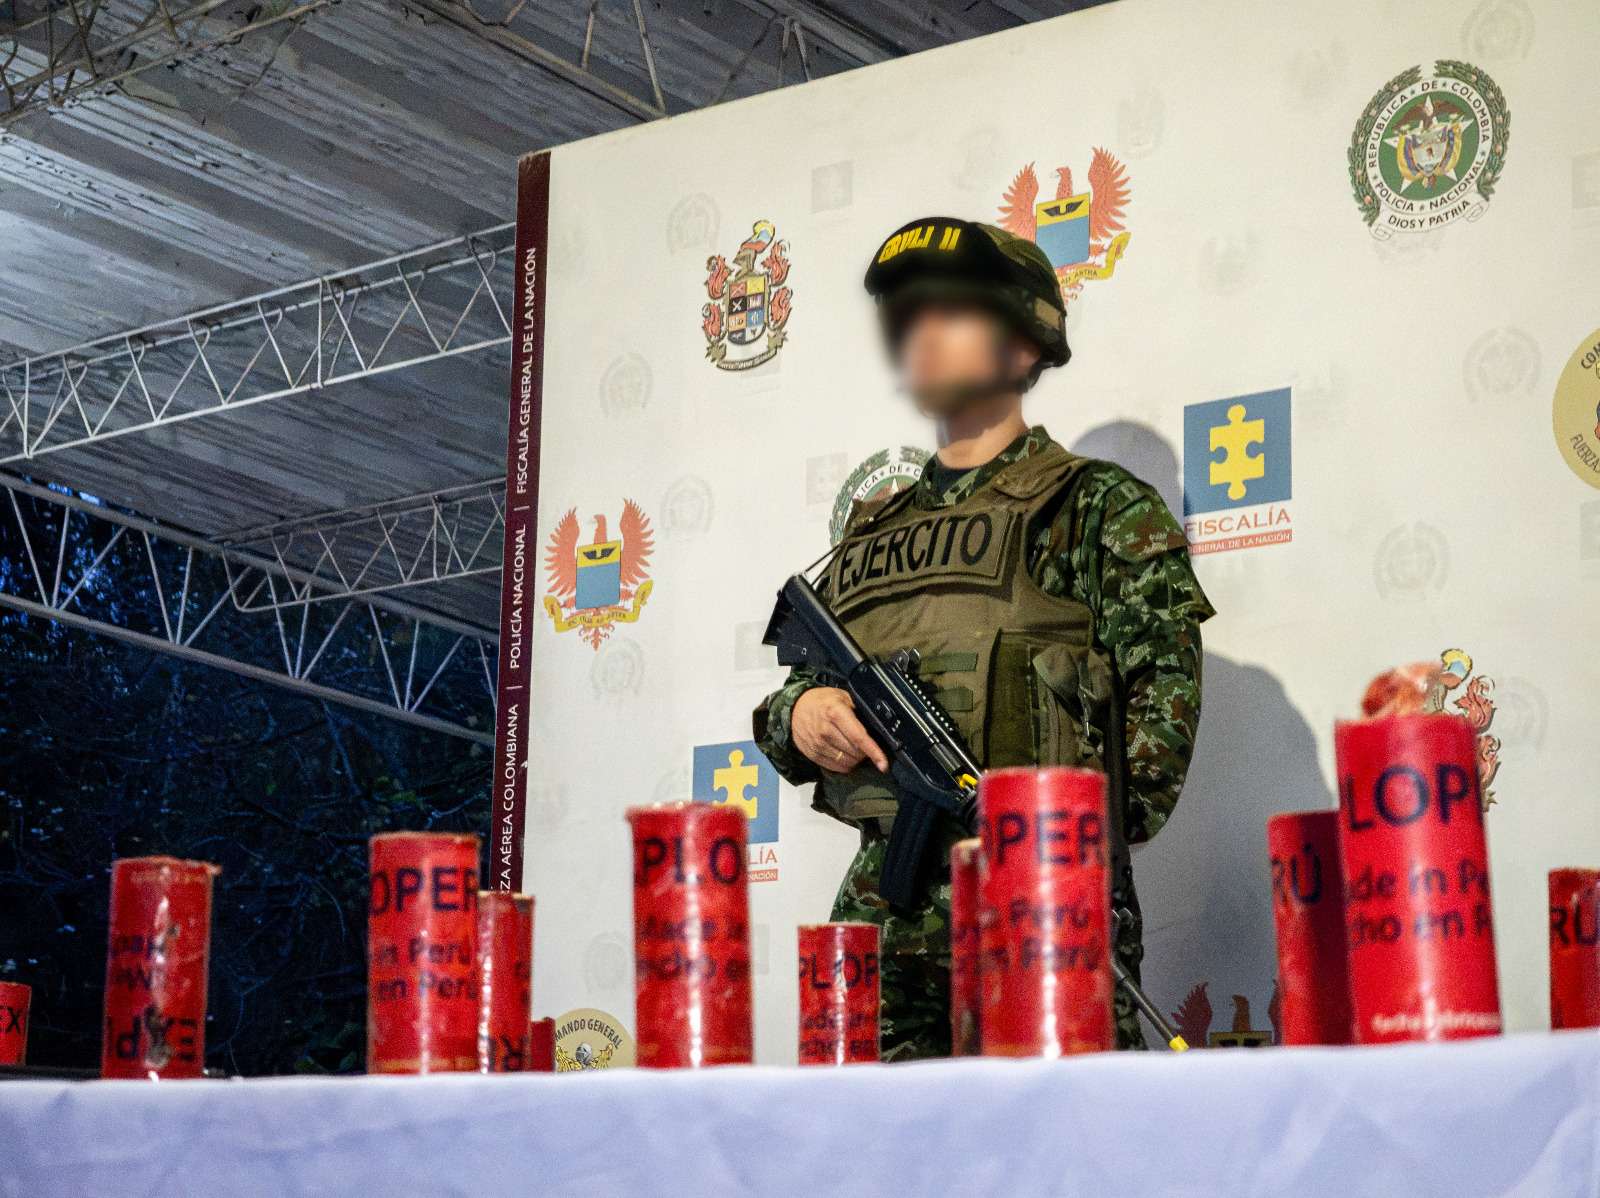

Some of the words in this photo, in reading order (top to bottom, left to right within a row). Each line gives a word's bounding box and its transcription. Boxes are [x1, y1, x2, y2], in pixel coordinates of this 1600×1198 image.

[1421, 80, 1438, 92] DE
[1451, 82, 1490, 143] COLOMBIA
[1429, 159, 1485, 211] NACIONAL
[1388, 214, 1416, 229] DIOS
[1417, 219, 1426, 229] Y
[1429, 200, 1472, 226] PATRIA
[525, 247, 537, 307] NACIÓN
[522, 331, 534, 353] DE
[523, 307, 535, 330] LA
[519, 355, 532, 426] GENERAL
[516, 427, 529, 495] FISCALÍA
[1570, 433, 1600, 473] FUERZA
[1184, 504, 1292, 537] FISCALÍA
[512, 523, 526, 605] NACIONAL
[839, 512, 993, 594] EJERCITO
[509, 607, 522, 669] POLICÍA
[503, 703, 519, 812] COLOMBIANA
[1342, 763, 1485, 830] LOP
[500, 813, 513, 866] AÉREA
[500, 868, 511, 894] ZA
[587, 1018, 623, 1050] GENERAL
